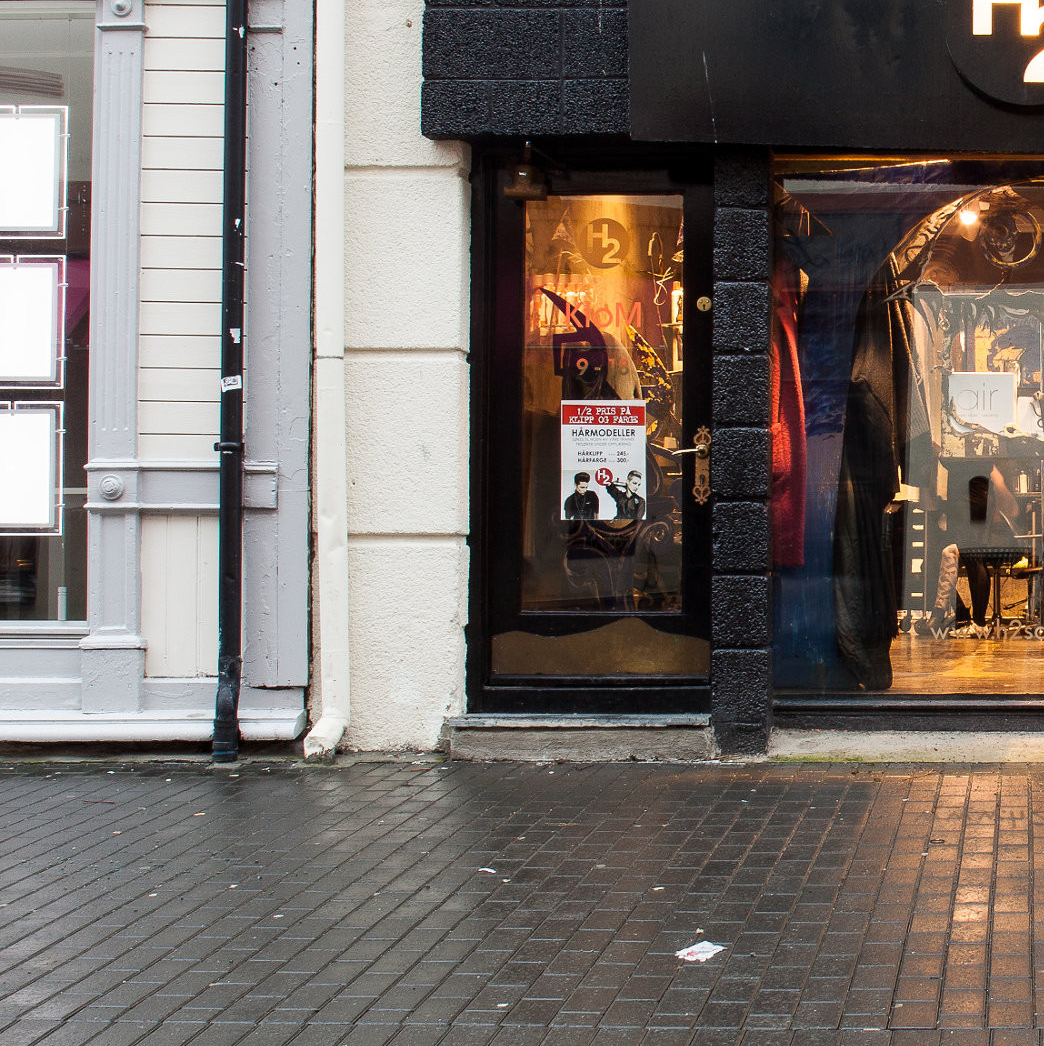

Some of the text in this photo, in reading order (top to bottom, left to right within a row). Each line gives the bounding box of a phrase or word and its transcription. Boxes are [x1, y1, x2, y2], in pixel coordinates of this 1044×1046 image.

[577, 406, 592, 416] 1/2
[596, 407, 616, 416] PRIS
[569, 416, 594, 424] KLIPP
[598, 416, 609, 424] OG
[572, 427, 636, 437] HÅRMODELLER
